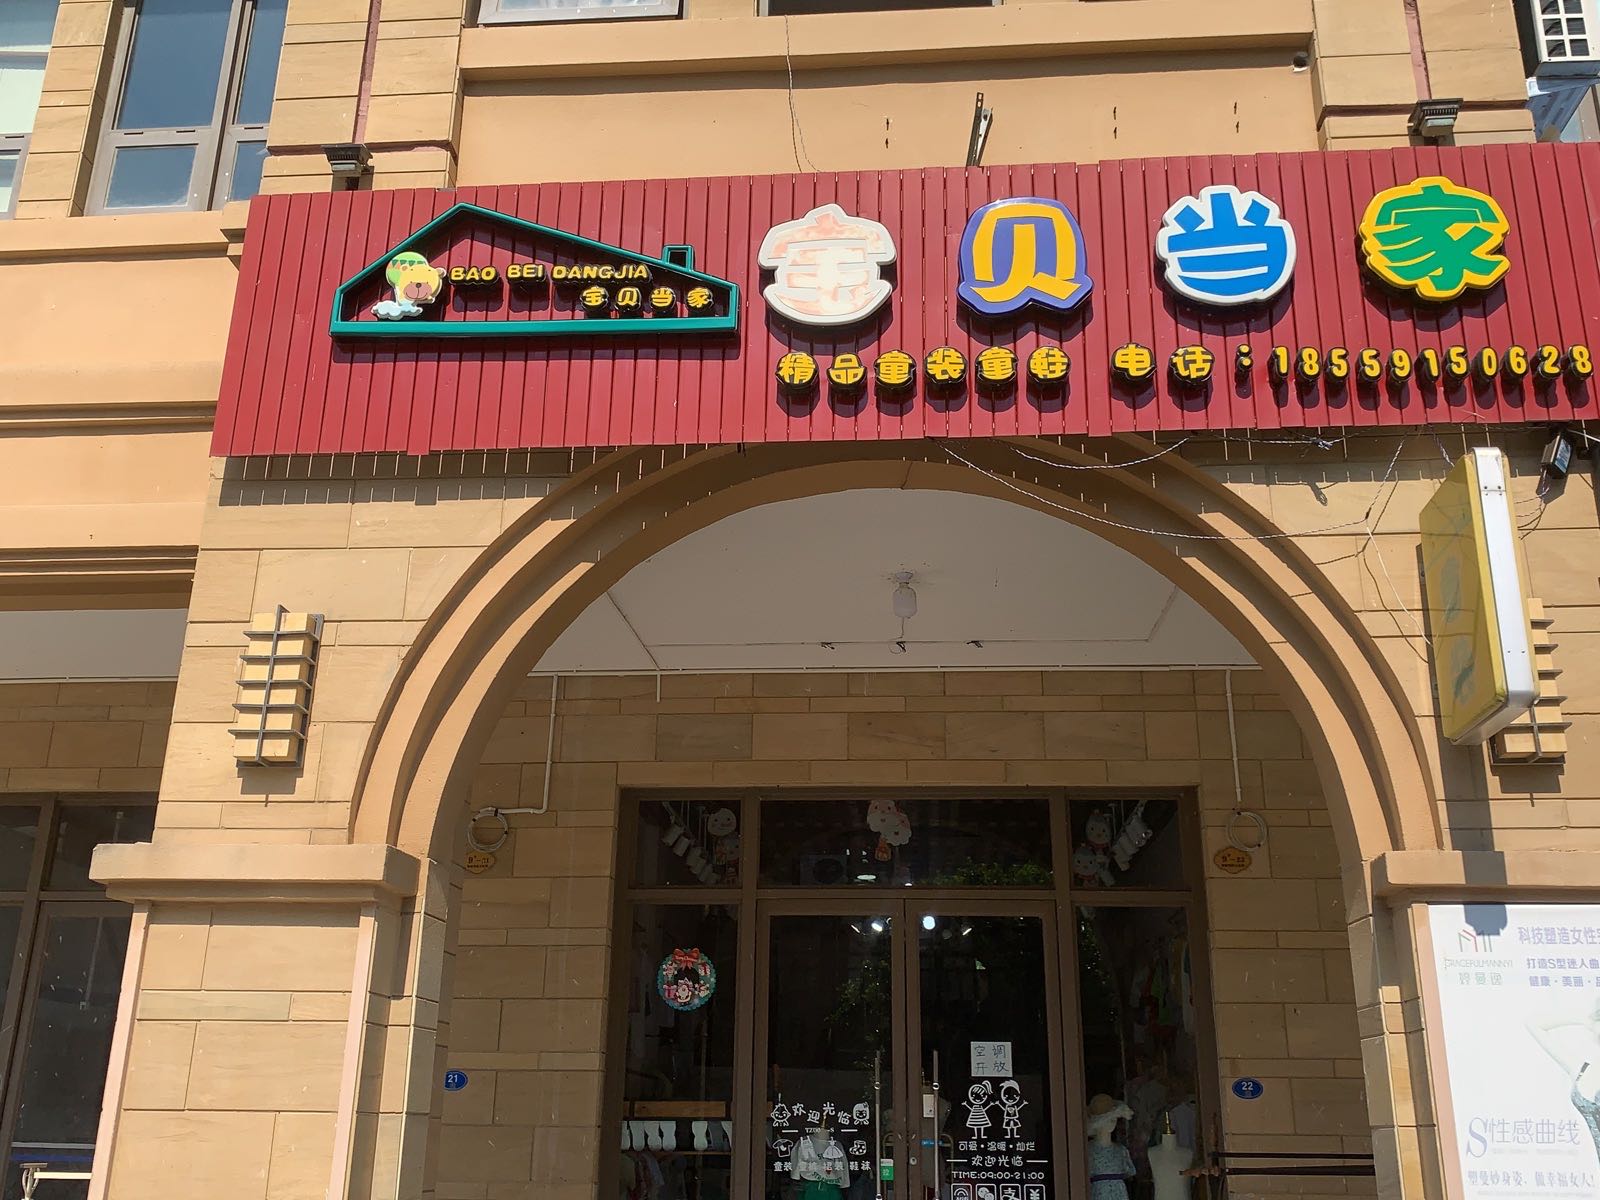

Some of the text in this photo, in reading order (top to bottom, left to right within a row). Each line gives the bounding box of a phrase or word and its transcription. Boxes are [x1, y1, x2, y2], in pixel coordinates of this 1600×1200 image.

[758, 174, 1511, 325] 宝贝当家
[450, 264, 649, 281] BAO BEI DANGJIA
[581, 286, 713, 311] 宝贝当家
[777, 345, 1070, 386] 精品童装童鞋
[974, 1045, 1006, 1059] 空调
[975, 1061, 1009, 1075] 开放
[447, 1074, 458, 1083] 21
[1241, 1081, 1253, 1090] 22
[792, 1102, 851, 1125] 欢迎光临
[971, 1154, 1024, 1168] 欢迎光临
